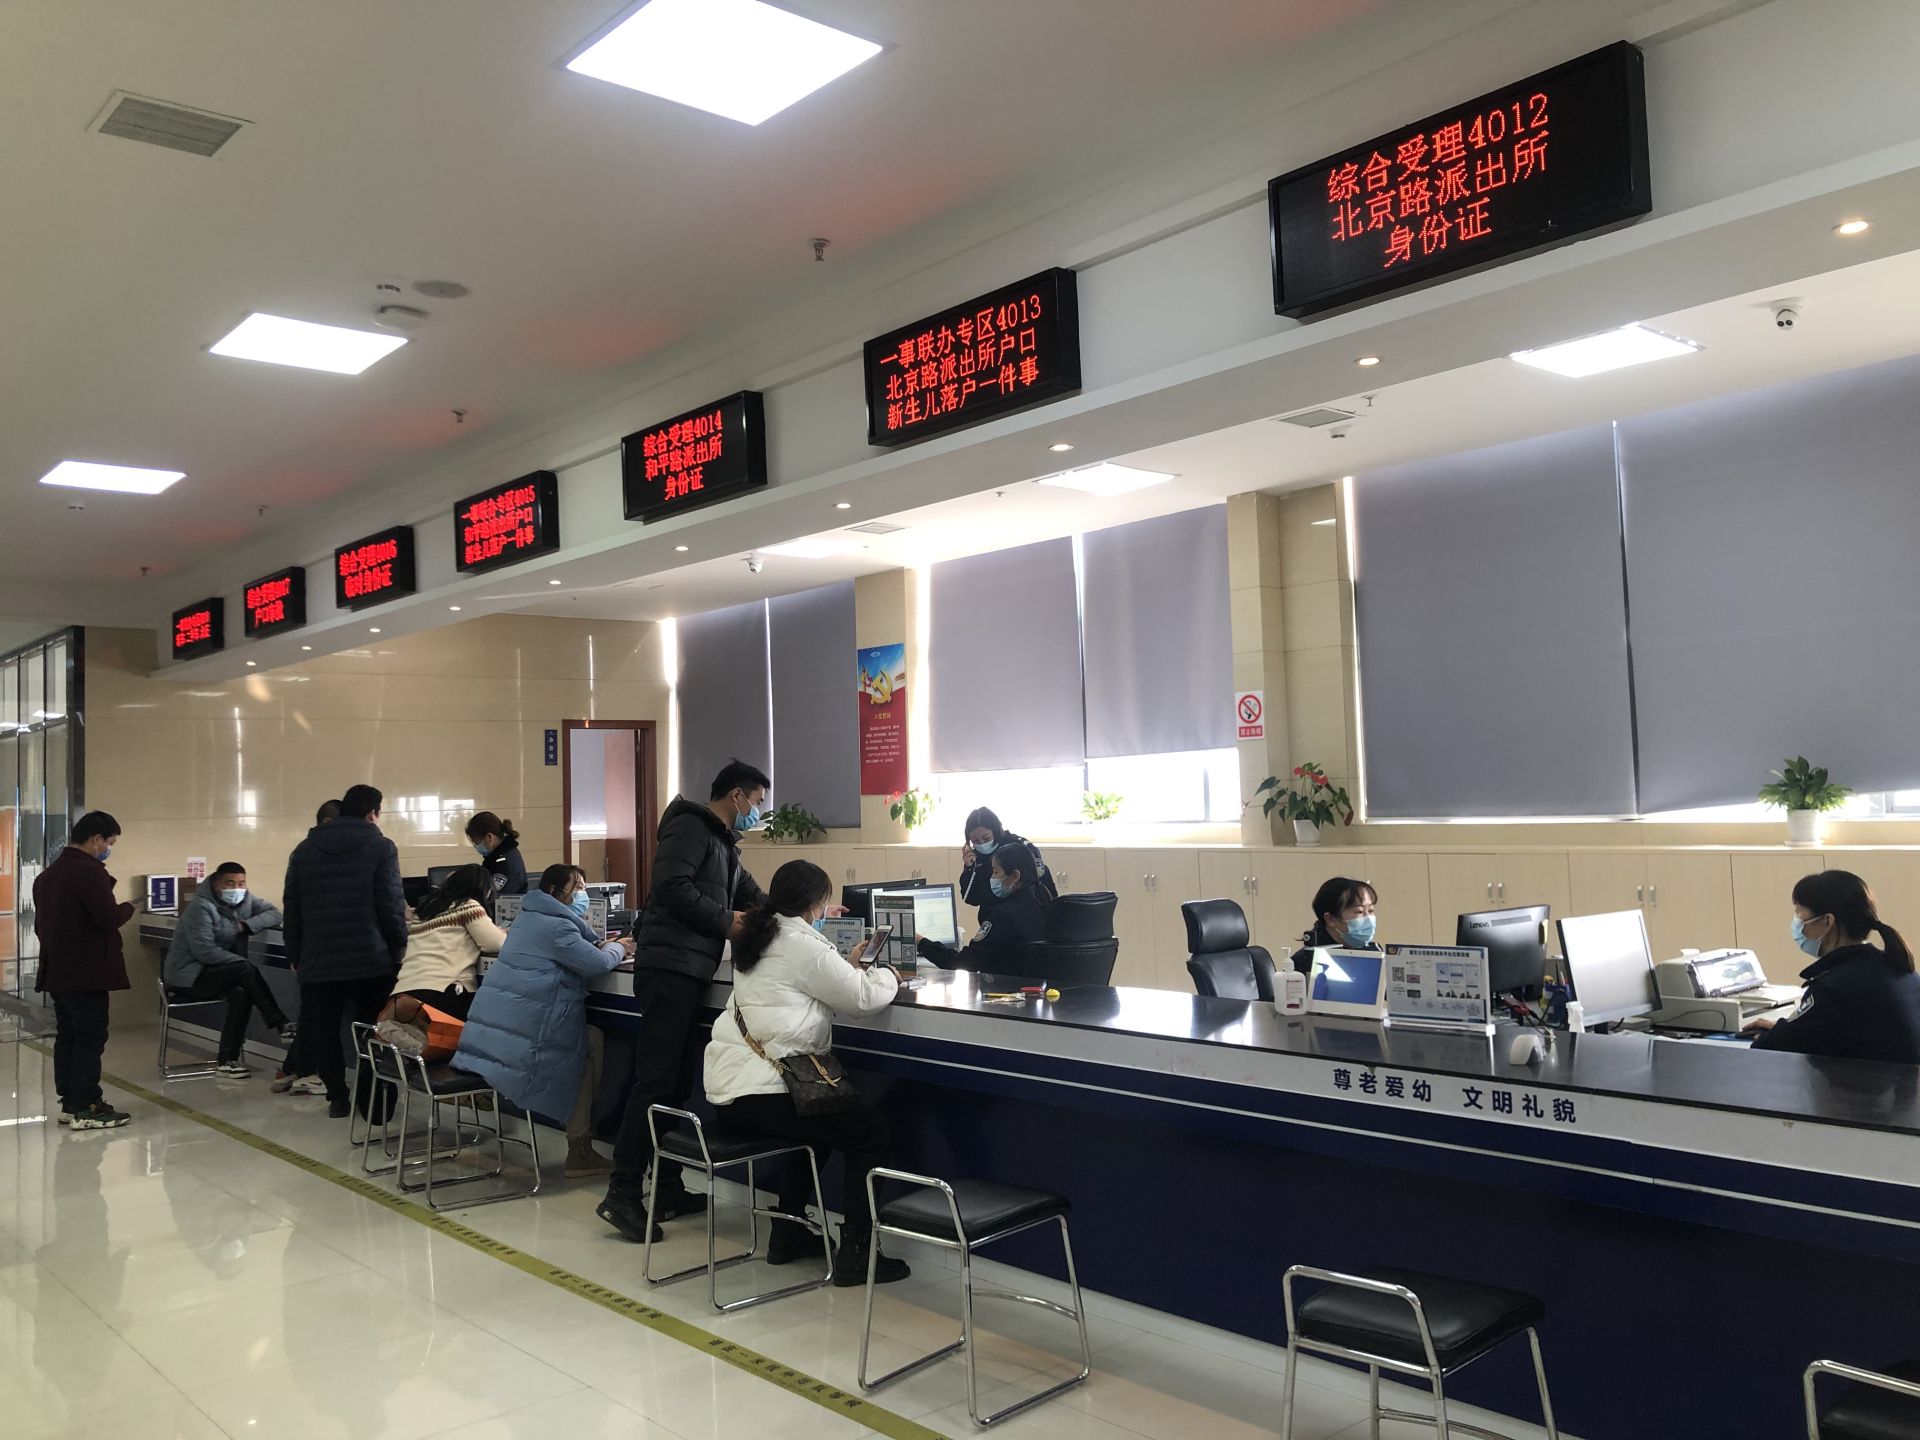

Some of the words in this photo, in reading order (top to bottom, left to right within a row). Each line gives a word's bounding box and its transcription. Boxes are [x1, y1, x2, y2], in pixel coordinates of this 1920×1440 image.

[1327, 92, 1549, 204] 综合受理4012
[1331, 130, 1549, 242] 北京路派出所
[1383, 197, 1492, 269] 身份证
[879, 294, 1041, 369] 一事联办专区4013
[886, 327, 1036, 402] 北京路派出所户口
[886, 355, 1040, 431] 新生儿落户一件事
[643, 410, 723, 457] 综合受理4014
[665, 467, 704, 500] 身份证
[1333, 1068, 1432, 1103] 尊老爱幼
[1462, 1085, 1577, 1124] 文明礼貌
